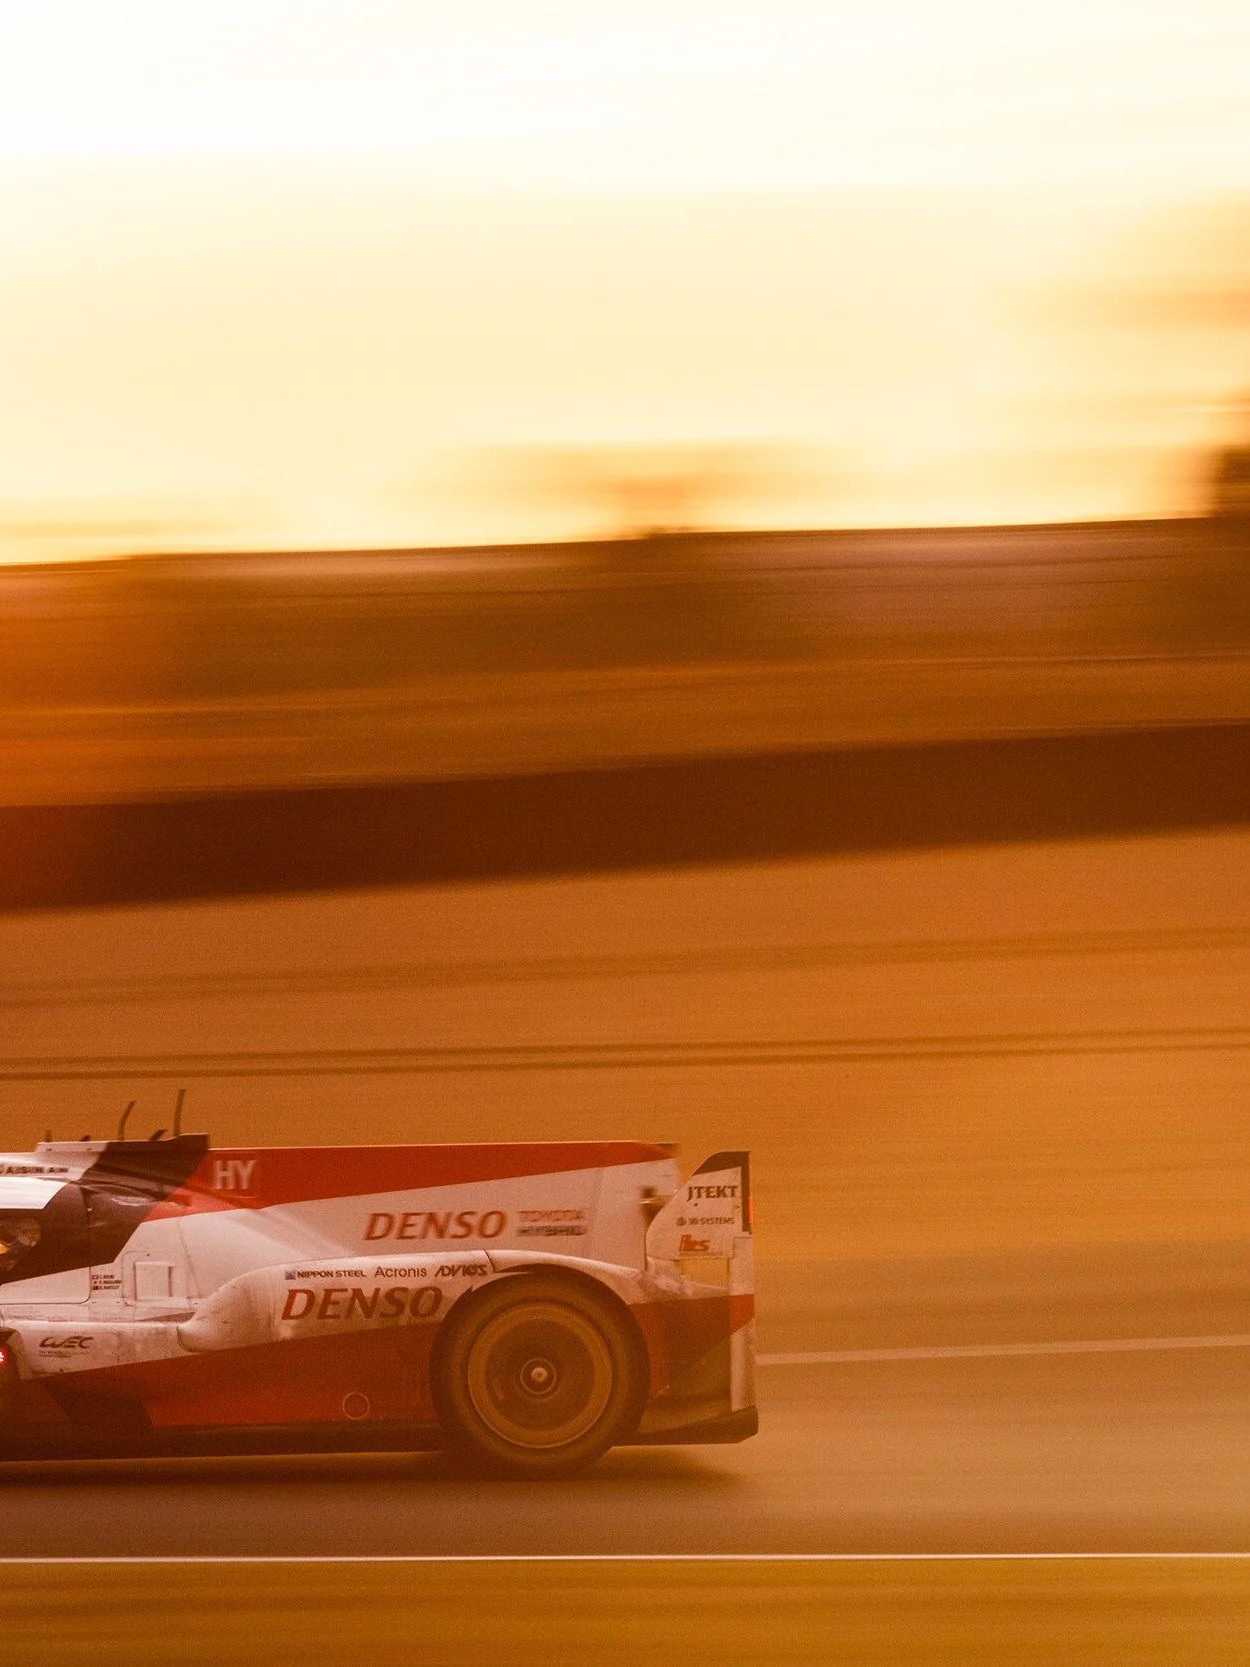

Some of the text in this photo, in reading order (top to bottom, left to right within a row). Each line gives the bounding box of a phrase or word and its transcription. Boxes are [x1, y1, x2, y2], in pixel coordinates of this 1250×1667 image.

[214, 1159, 256, 1190] HY
[686, 1185, 739, 1202] JTEKT
[363, 1210, 508, 1241] DENSO
[297, 1269, 367, 1280] NIPPON STEEL
[374, 1266, 427, 1279] Acronis
[281, 1286, 443, 1321] DENSO
[39, 1335, 94, 1349] WEC
